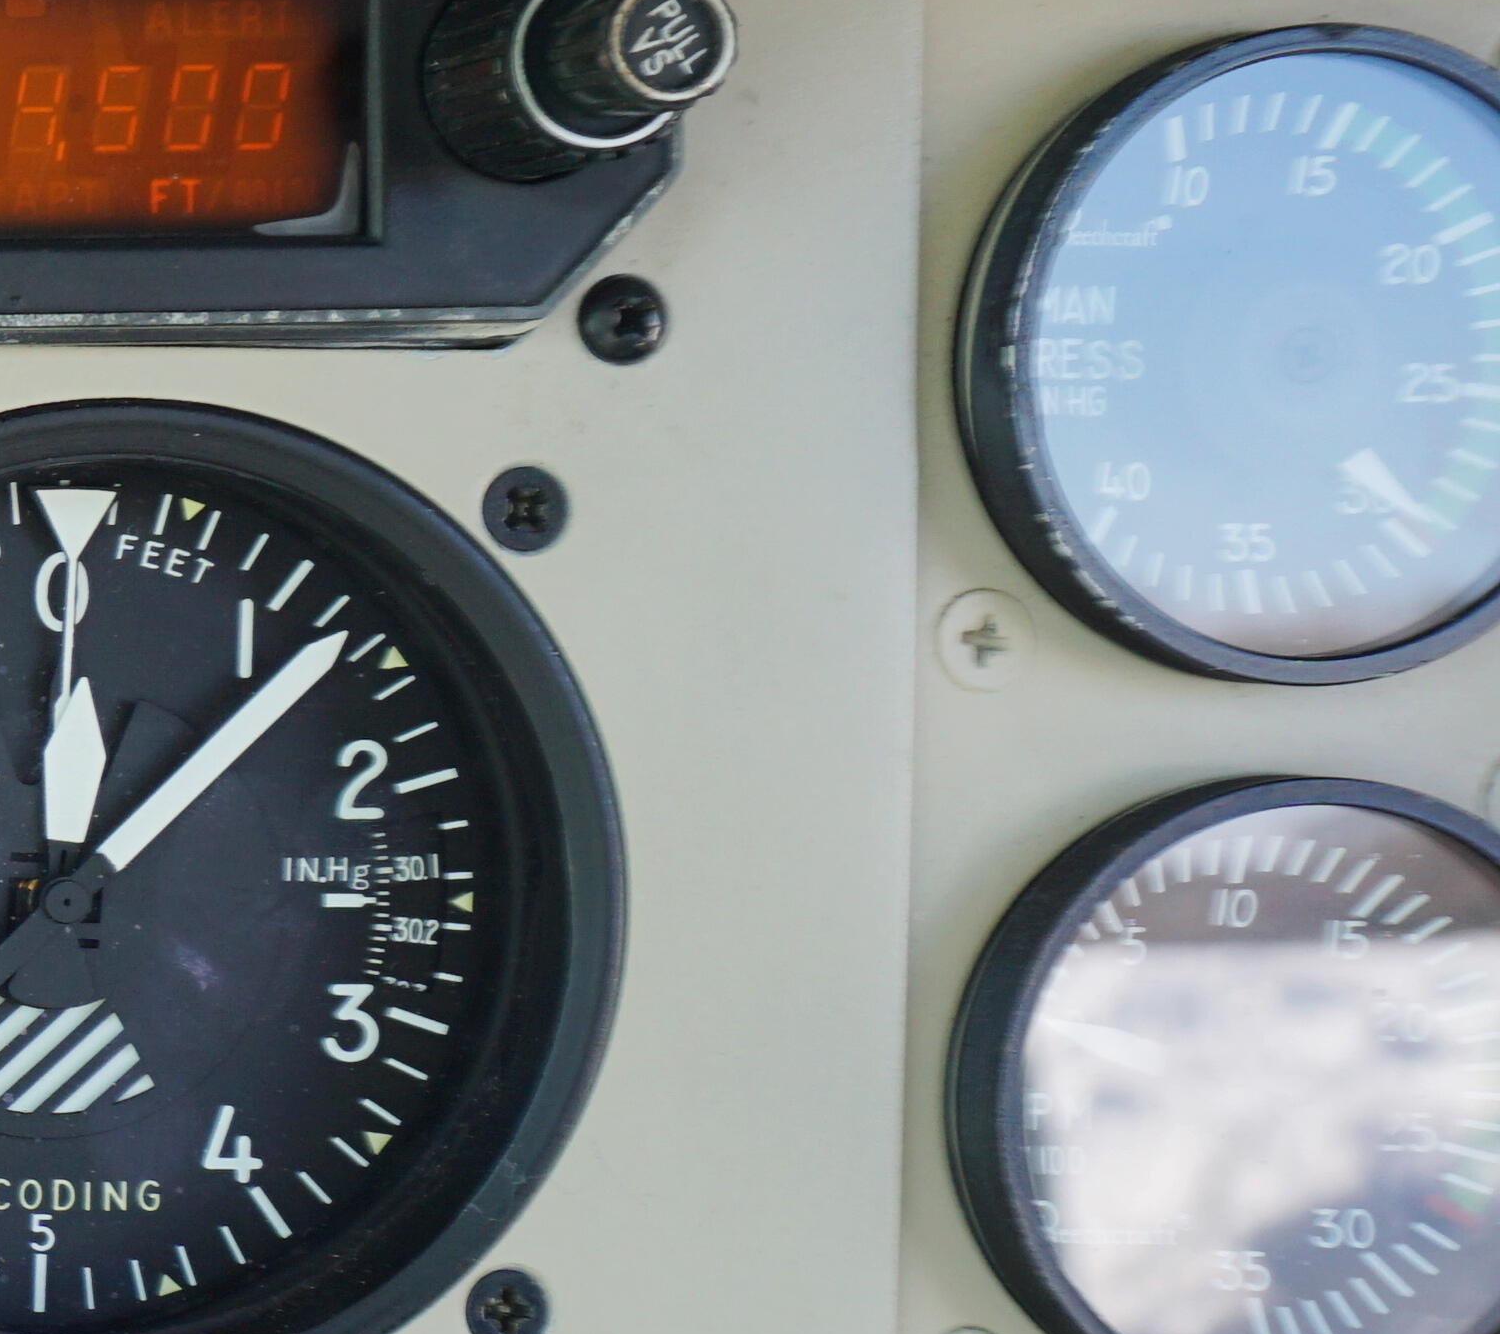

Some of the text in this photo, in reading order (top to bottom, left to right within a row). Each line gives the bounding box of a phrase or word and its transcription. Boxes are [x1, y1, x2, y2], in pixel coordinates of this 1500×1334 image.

[1164, 164, 1209, 208] 10
[1288, 155, 1337, 196] 15
[1379, 243, 1441, 286] 20
[1401, 363, 1458, 404] 25
[1100, 461, 1152, 501] 40
[114, 533, 217, 587] FEET
[1216, 523, 1276, 563] 35
[34, 549, 90, 634] 0
[335, 739, 386, 821] 2
[1211, 888, 1257, 928] 10
[1324, 919, 1370, 959] 15
[320, 982, 381, 1065] 3
[201, 1104, 263, 1183] 4
[27, 1213, 57, 1251] 5
[1310, 1208, 1375, 1249] 30
[1211, 1251, 1270, 1291] 35
